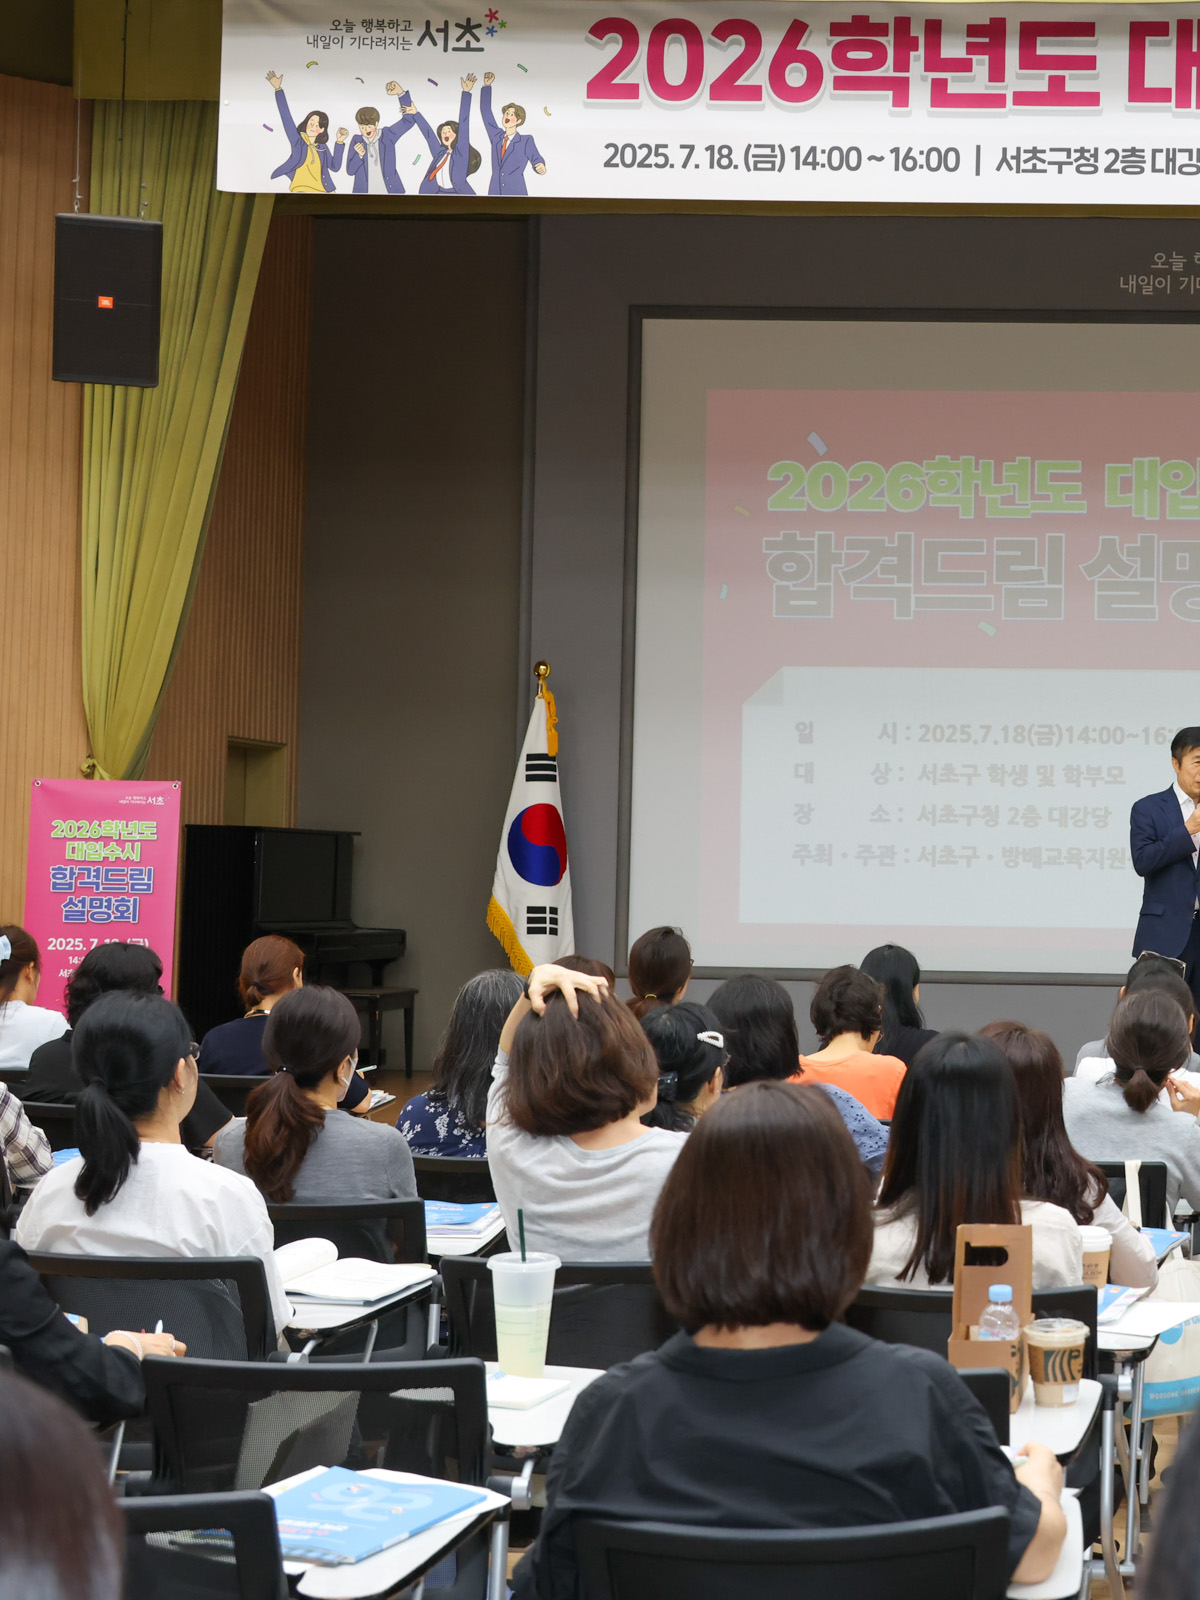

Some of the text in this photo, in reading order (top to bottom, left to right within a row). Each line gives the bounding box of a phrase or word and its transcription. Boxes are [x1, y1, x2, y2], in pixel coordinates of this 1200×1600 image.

[329, 19, 413, 33] 오늘 행복하고
[416, 17, 485, 52] 서초
[306, 35, 413, 51] 내일이 기다려지는
[585, 15, 1101, 108] 2026학년도
[995, 146, 1099, 175] 서초구청
[1103, 147, 1147, 174] 2층
[1150, 251, 1188, 271] 오늘
[1119, 274, 1172, 296] 내일이
[766, 455, 1088, 519] 2026학년도
[762, 531, 1066, 621] 합격드림
[917, 763, 981, 787] 서초구
[986, 763, 1029, 787] 학생
[1035, 763, 1056, 787] 및
[1062, 764, 1126, 788] 학부모
[917, 804, 1001, 828] 서초구청
[1007, 805, 1042, 829] 2층
[1048, 806, 1112, 829] 대강당
[51, 820, 158, 840] 2026학년도
[66, 842, 141, 861] 대입수시
[792, 843, 834, 867] 주최
[855, 843, 898, 867] 주관
[917, 844, 981, 868] 서초구
[1001, 845, 1131, 871] 방배교육지원
[50, 865, 154, 893] 합격드림
[61, 896, 140, 923] 설명회
